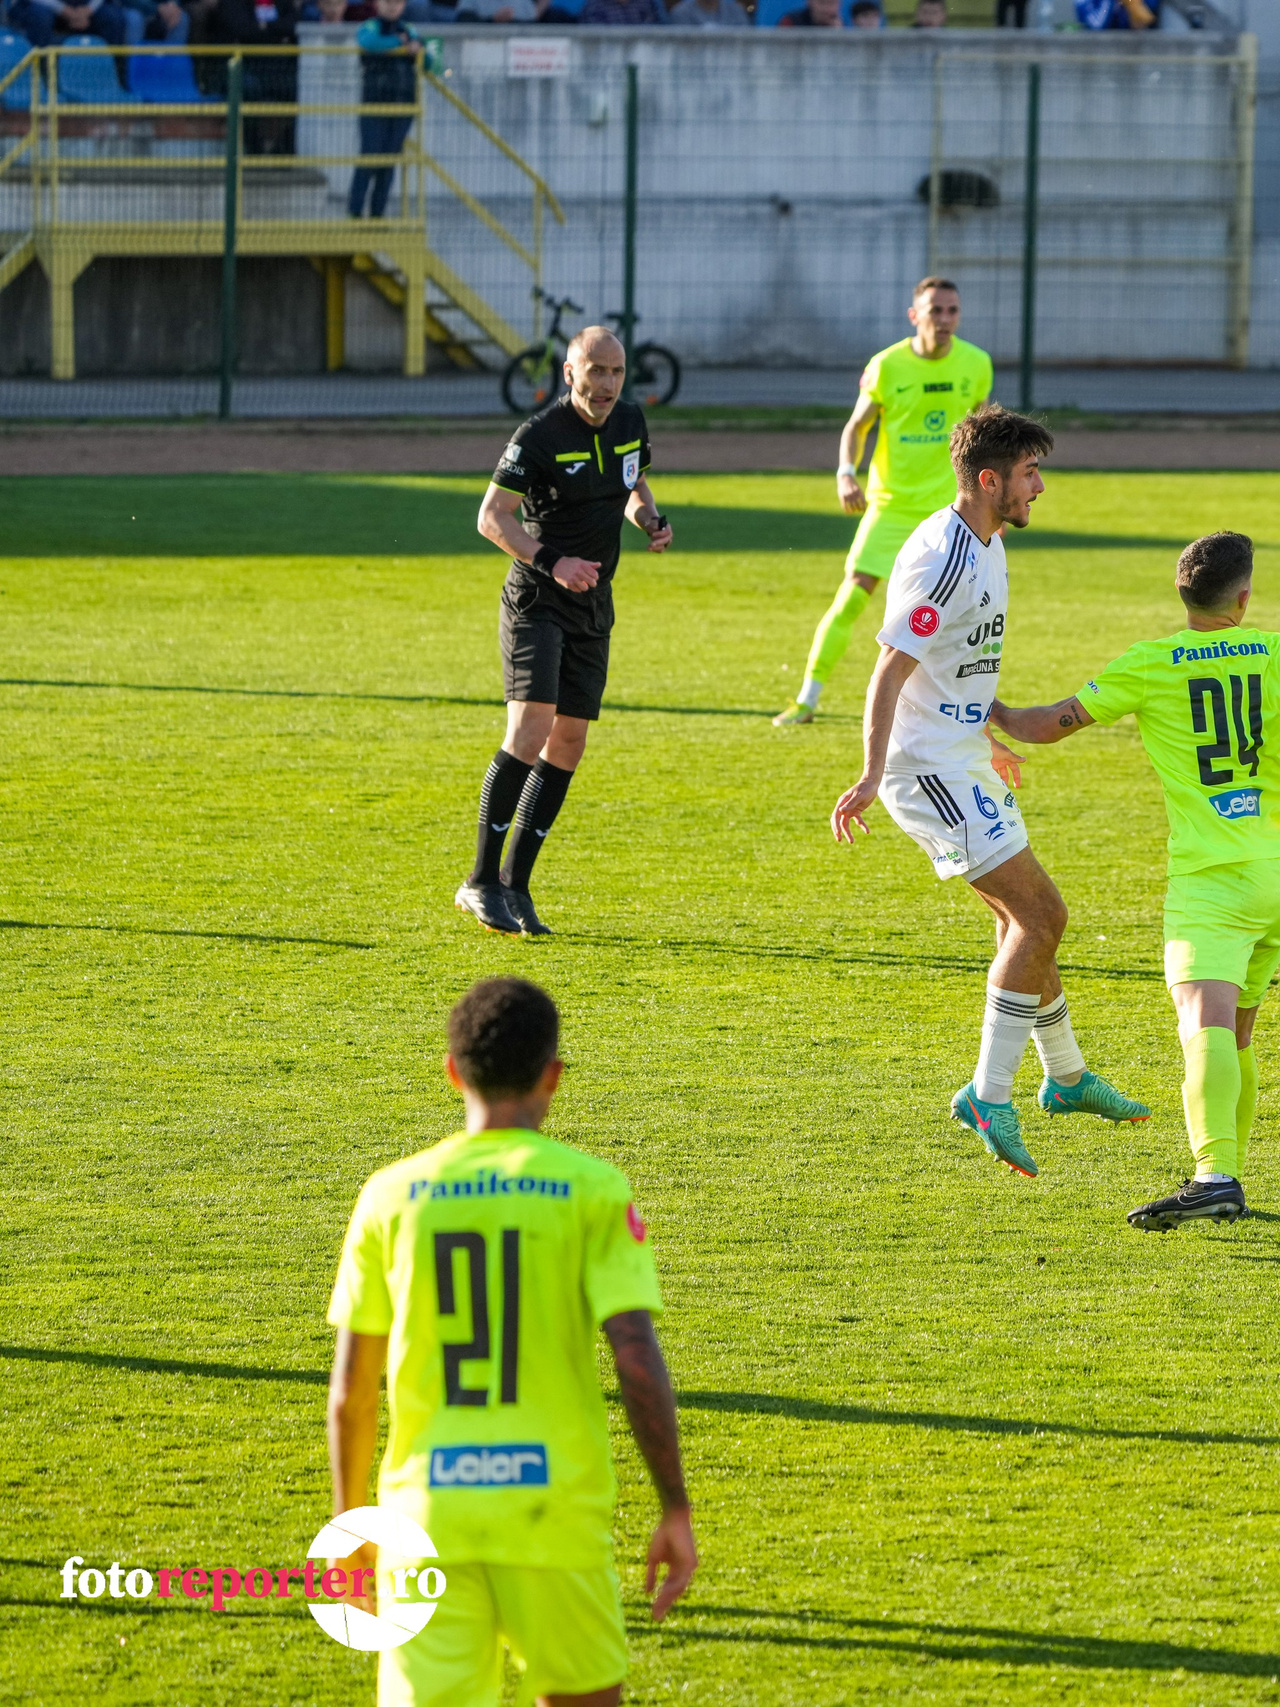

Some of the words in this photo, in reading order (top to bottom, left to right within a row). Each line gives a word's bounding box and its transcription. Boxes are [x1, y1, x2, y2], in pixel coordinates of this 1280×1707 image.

[1171, 640, 1269, 664] Panifcom
[1188, 673, 1264, 786] 24
[972, 784, 999, 820] 6
[410, 1169, 570, 1200] Panifcom
[434, 1229, 520, 1406] 21
